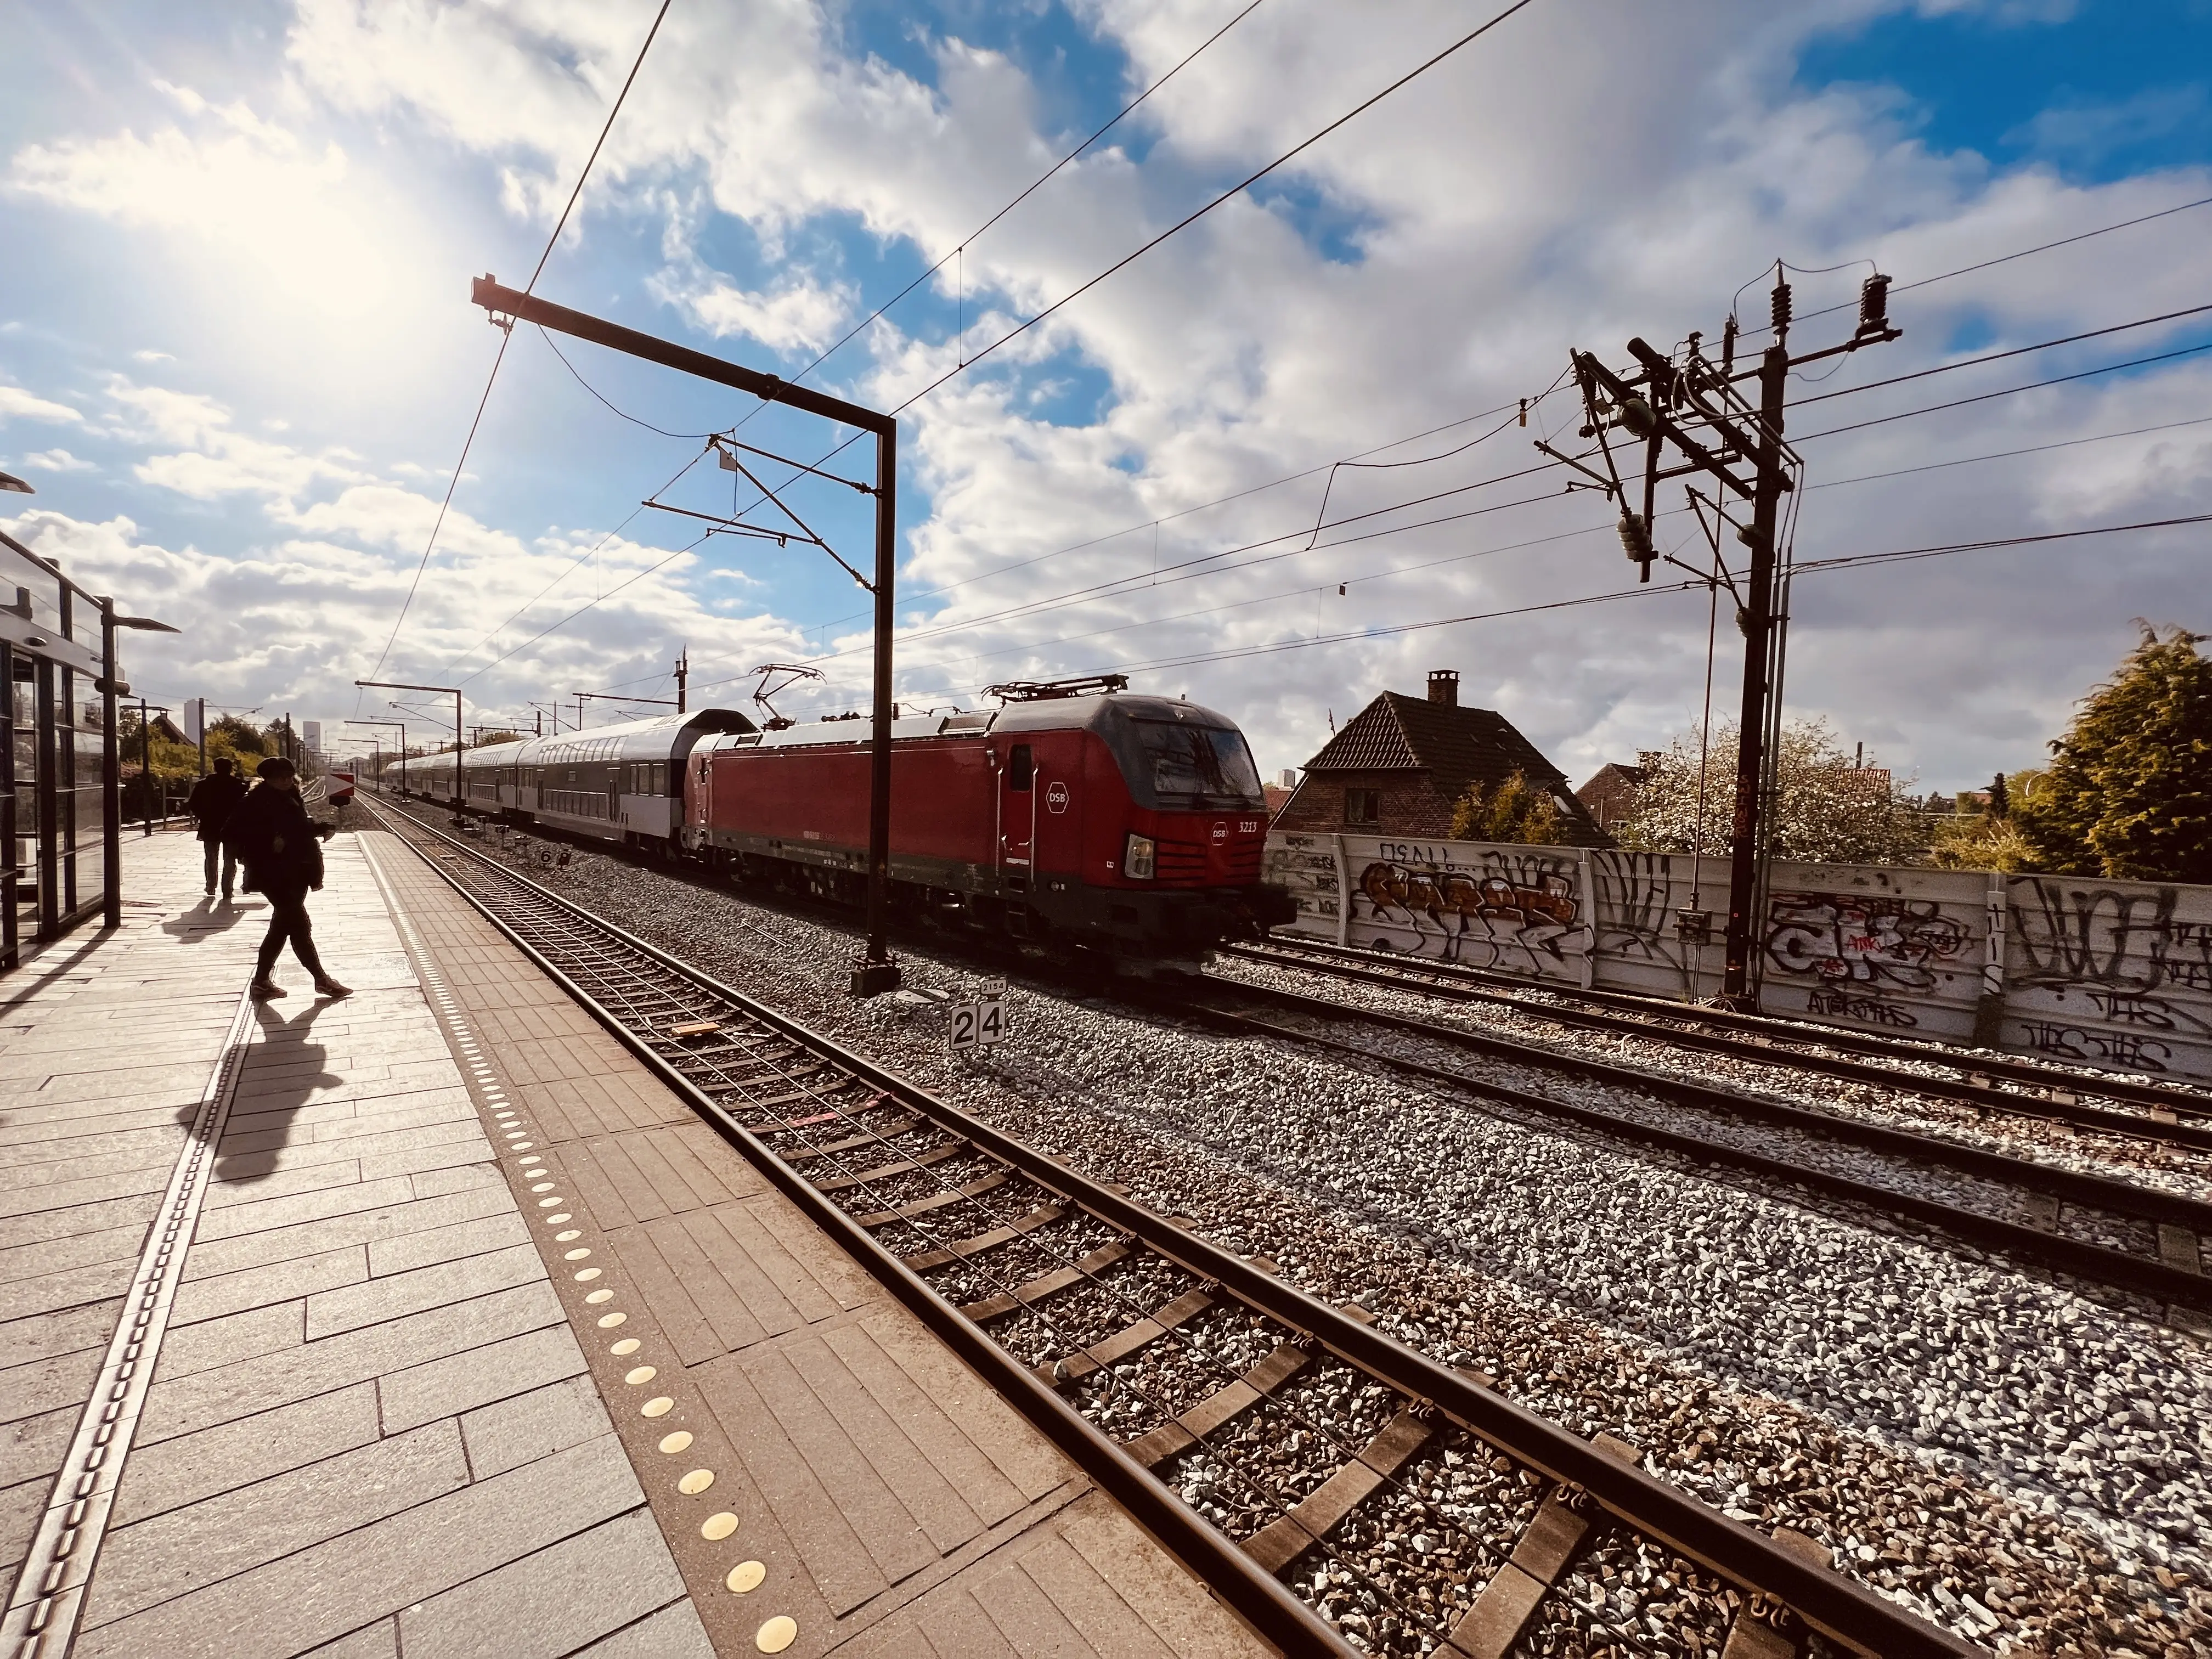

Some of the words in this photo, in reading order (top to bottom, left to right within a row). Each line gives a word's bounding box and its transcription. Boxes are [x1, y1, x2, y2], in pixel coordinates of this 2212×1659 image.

[1049, 793, 1065, 803] DSB
[1238, 822, 1257, 833] 3213
[983, 983, 1003, 991] 2154
[953, 1006, 1003, 1045] 24
